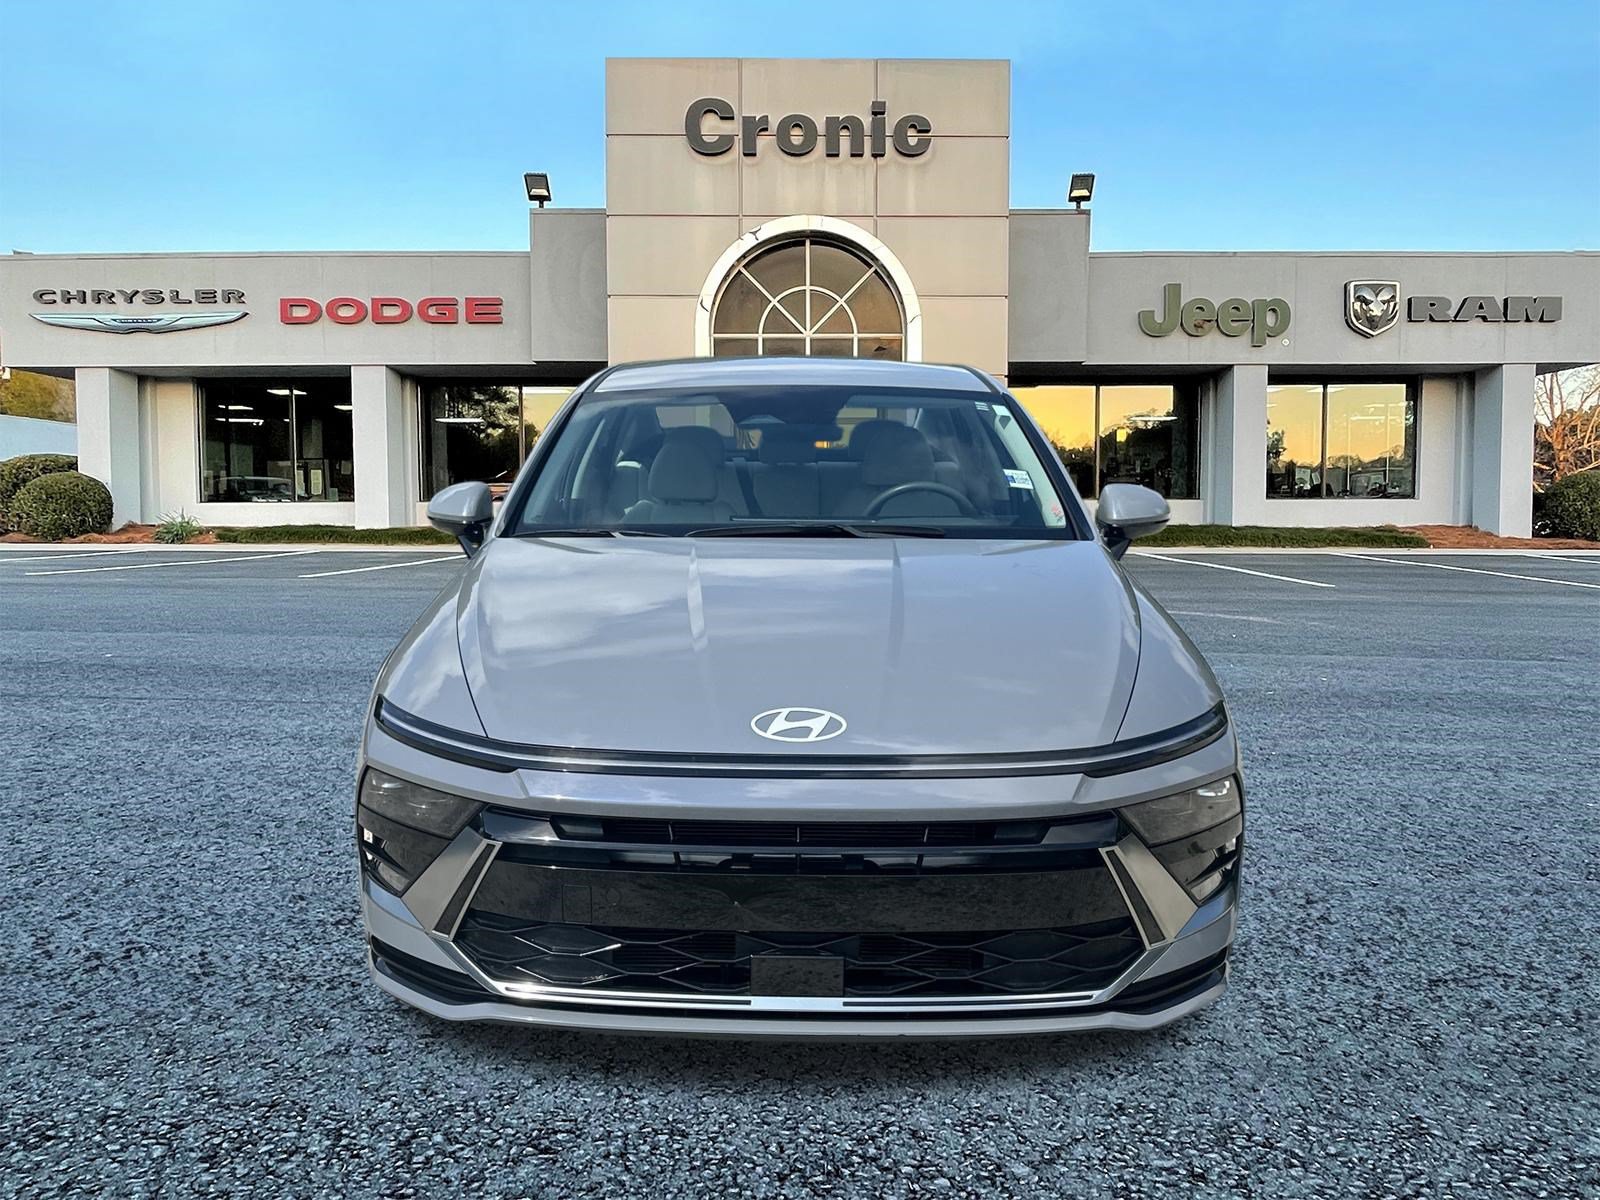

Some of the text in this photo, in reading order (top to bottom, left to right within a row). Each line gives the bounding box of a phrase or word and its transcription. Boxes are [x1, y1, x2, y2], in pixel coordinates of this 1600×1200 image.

[685, 97, 932, 157] Cronic
[32, 289, 246, 304] CHRYSLER
[1407, 296, 1563, 323] RAM
[280, 297, 503, 324] DODGE
[1138, 283, 1291, 347] Jeep
